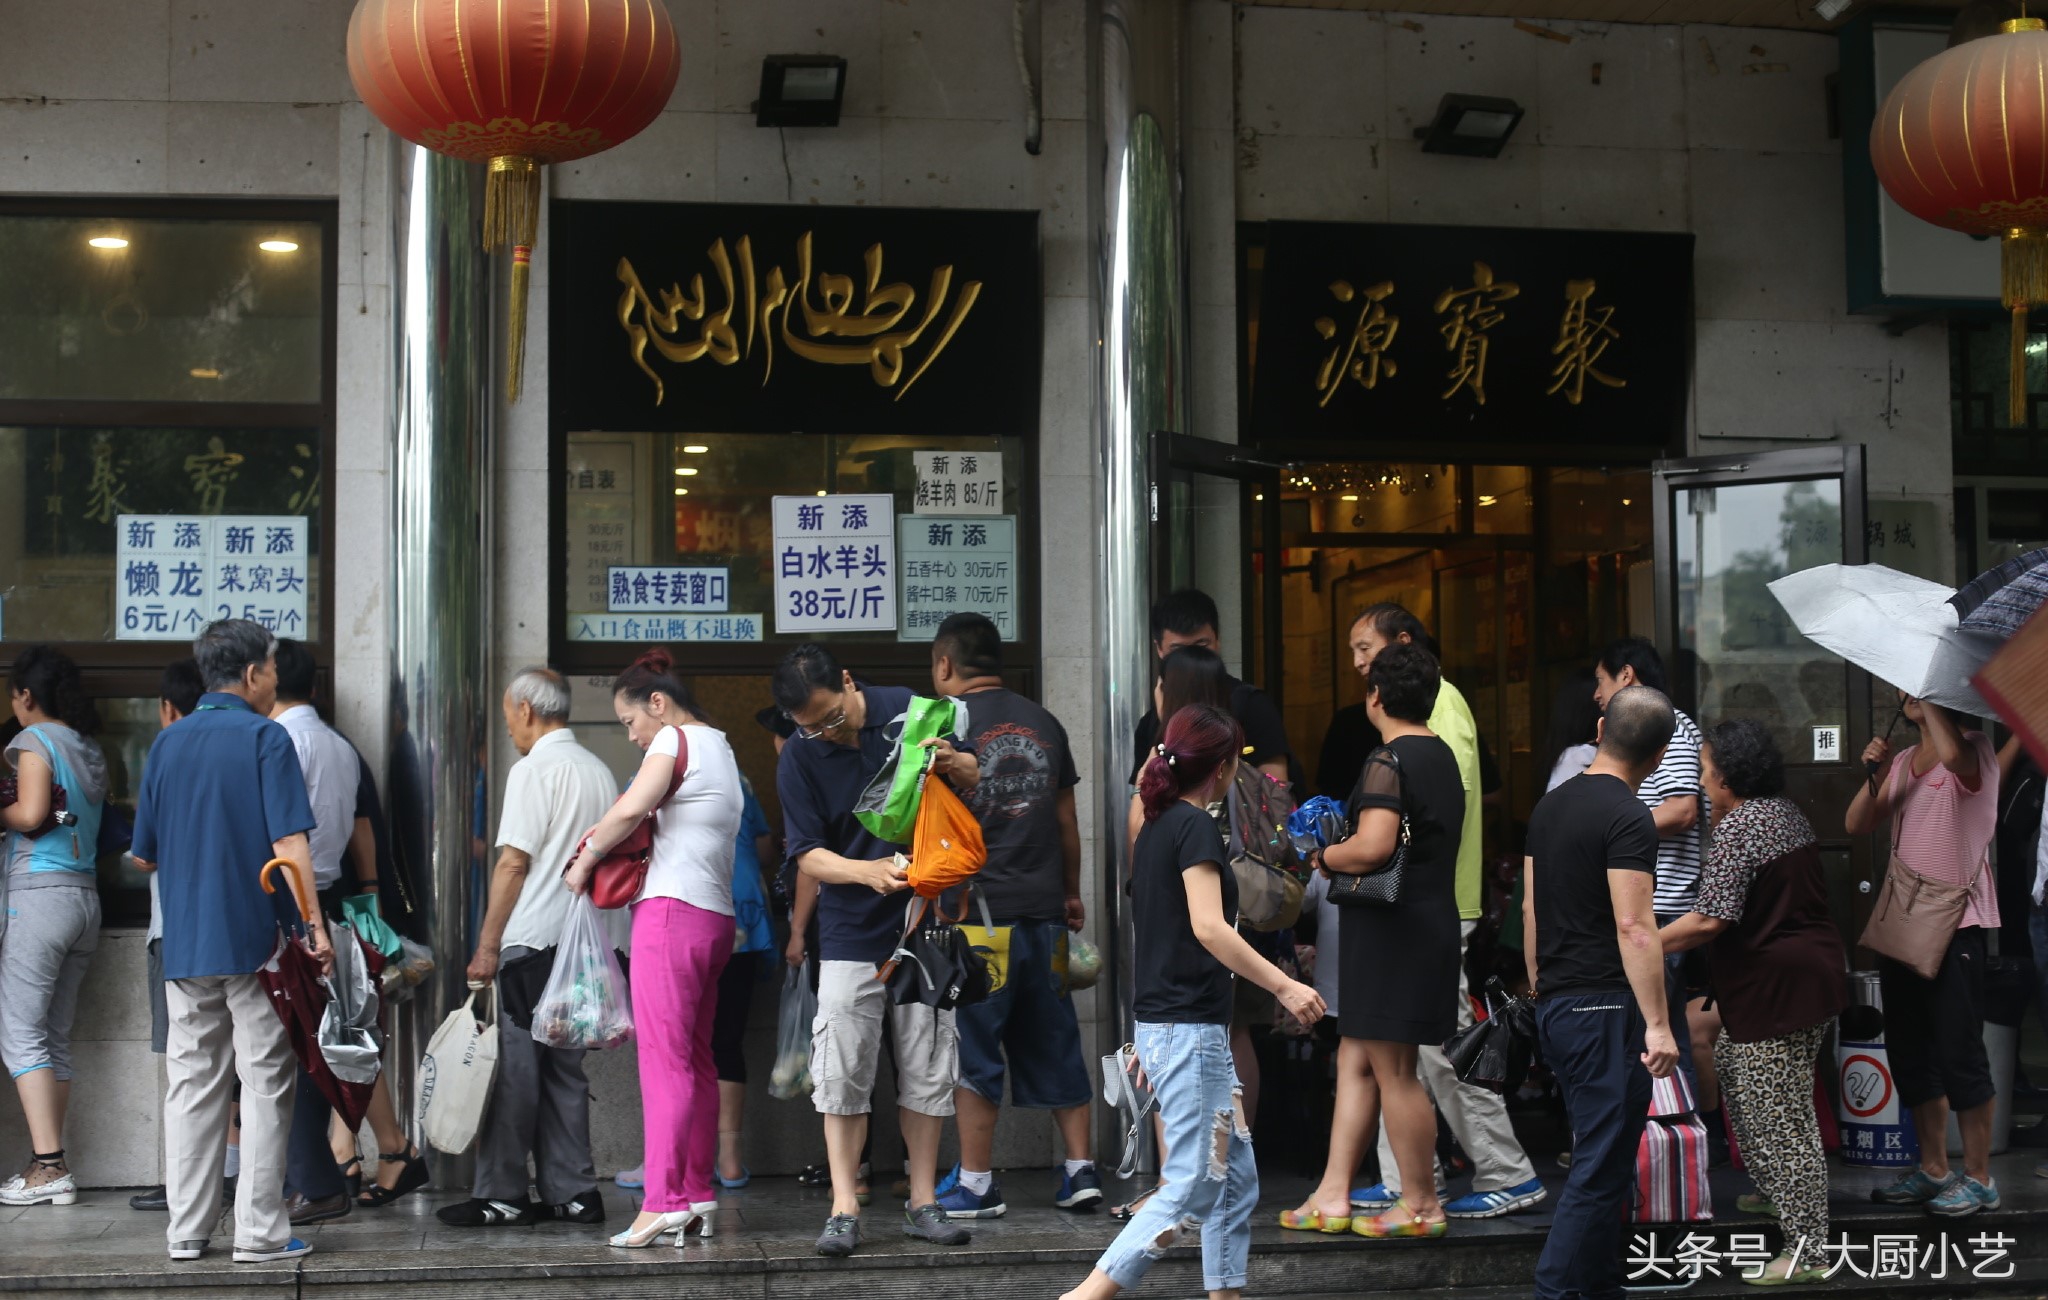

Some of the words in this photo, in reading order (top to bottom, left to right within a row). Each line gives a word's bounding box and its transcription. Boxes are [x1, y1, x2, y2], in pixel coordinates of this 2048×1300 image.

[931, 456, 978, 475] 新添
[916, 479, 957, 507] 烧羊肉
[963, 480, 998, 507] 85/斤
[797, 504, 868, 531] 新添
[127, 521, 201, 548] 新添
[225, 526, 295, 554] 新添
[928, 523, 987, 547] 新添
[782, 544, 887, 579] 白水羊头
[906, 560, 957, 578] 五香牛心
[964, 561, 1008, 579] 30元/斤
[125, 560, 203, 598] 懒龙
[217, 563, 304, 595] 菜窝头
[612, 571, 725, 605] 熟食专卖窗口
[789, 585, 885, 620] 38元/斤
[906, 585, 957, 604] 酱牛口条
[964, 585, 1009, 604] 70元/斤
[124, 604, 204, 634] 6元/个
[217, 604, 302, 632] 25元/个
[576, 617, 756, 641] 入口食品概不退换
[978, 737, 1021, 767] BEIJING
[1817, 731, 1835, 749] 推
[1876, 1152, 1912, 1161] AREA
